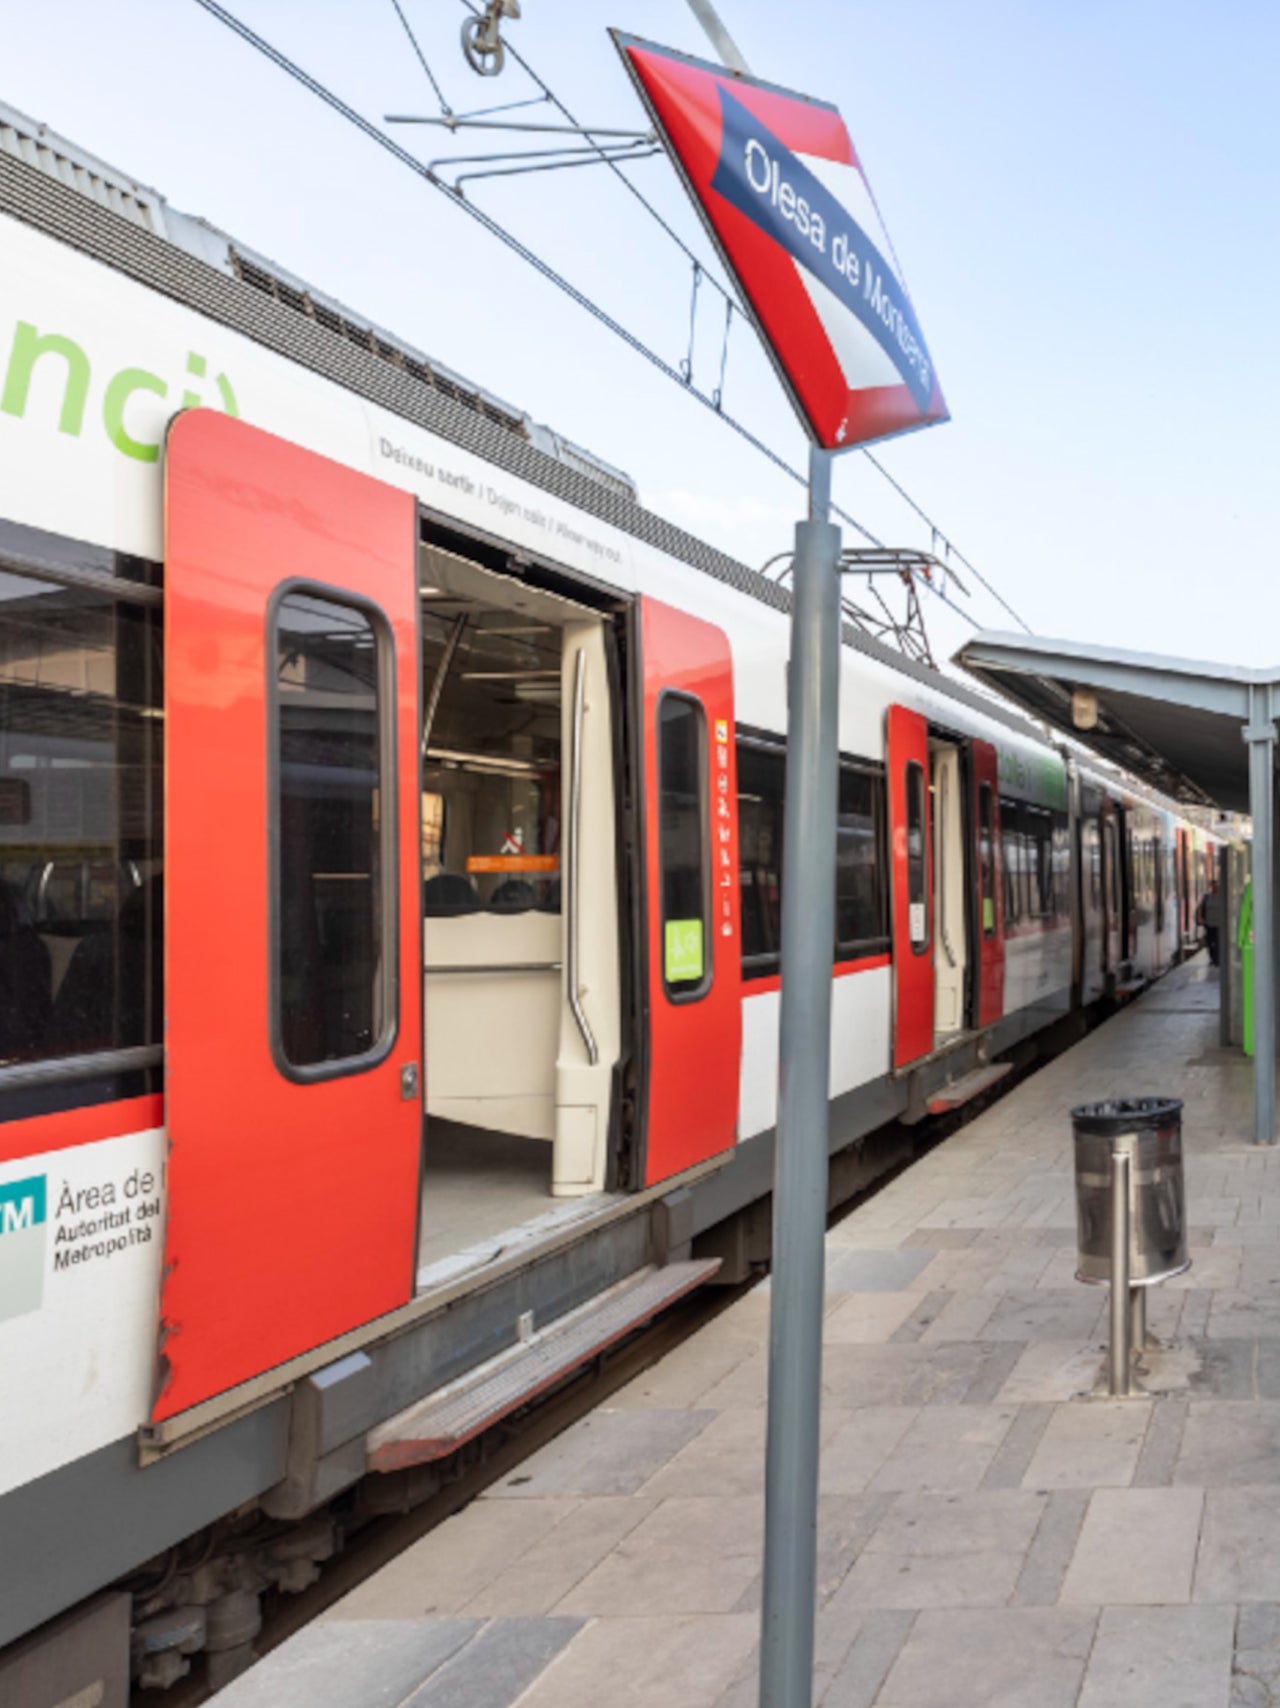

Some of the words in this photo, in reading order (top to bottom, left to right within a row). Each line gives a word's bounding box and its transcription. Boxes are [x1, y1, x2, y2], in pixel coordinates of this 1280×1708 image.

[745, 138, 826, 253] Olesa
[832, 233, 859, 286] de
[55, 1180, 117, 1219] Àrea
[124, 1168, 155, 1198] de
[55, 1208, 130, 1245] Autoritat
[136, 1197, 160, 1221] del
[53, 1225, 153, 1272] Metropolità
